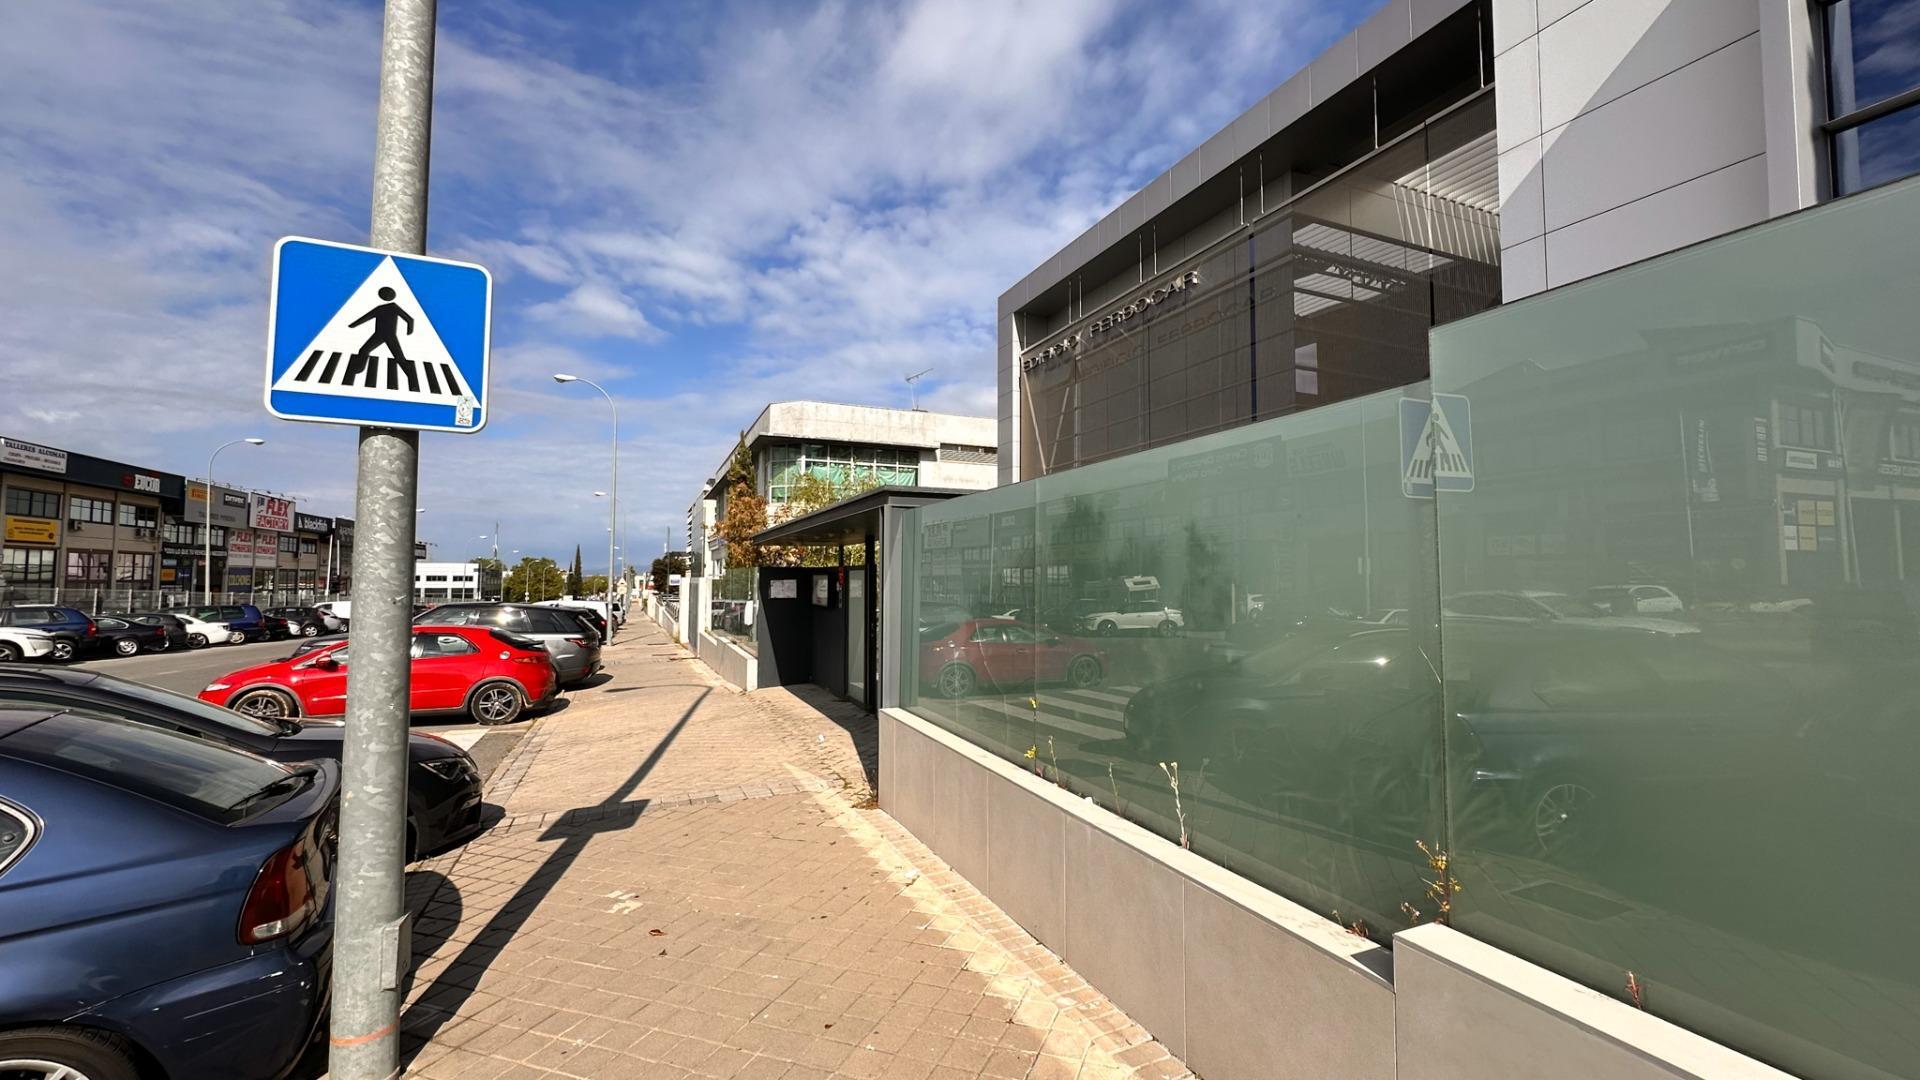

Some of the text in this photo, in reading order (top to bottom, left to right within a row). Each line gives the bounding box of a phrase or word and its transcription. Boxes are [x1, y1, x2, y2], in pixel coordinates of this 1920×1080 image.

[1023, 333, 1081, 372] EDIFICIO
[5, 440, 36, 453] TALLERES
[265, 498, 289, 517] FLEX
[255, 514, 289, 531] FACTORY
[304, 515, 328, 532] blackfish
[236, 530, 252, 543] FLEX
[262, 533, 277, 546] FLEX
